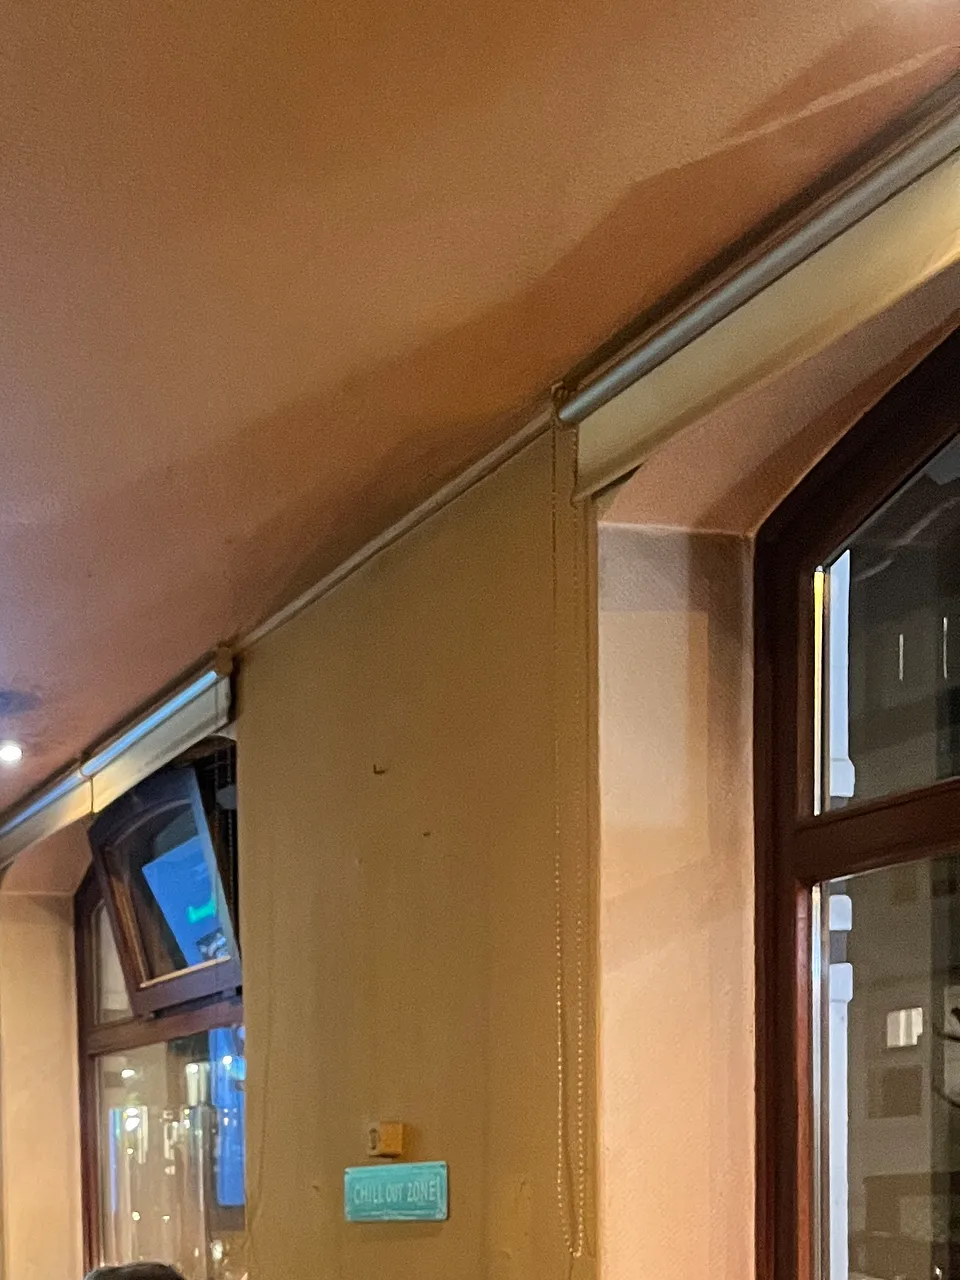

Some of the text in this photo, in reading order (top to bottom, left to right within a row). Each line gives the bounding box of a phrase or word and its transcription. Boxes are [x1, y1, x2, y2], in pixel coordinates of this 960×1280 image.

[353, 1180, 437, 1205] CHILL OUT ZONE
